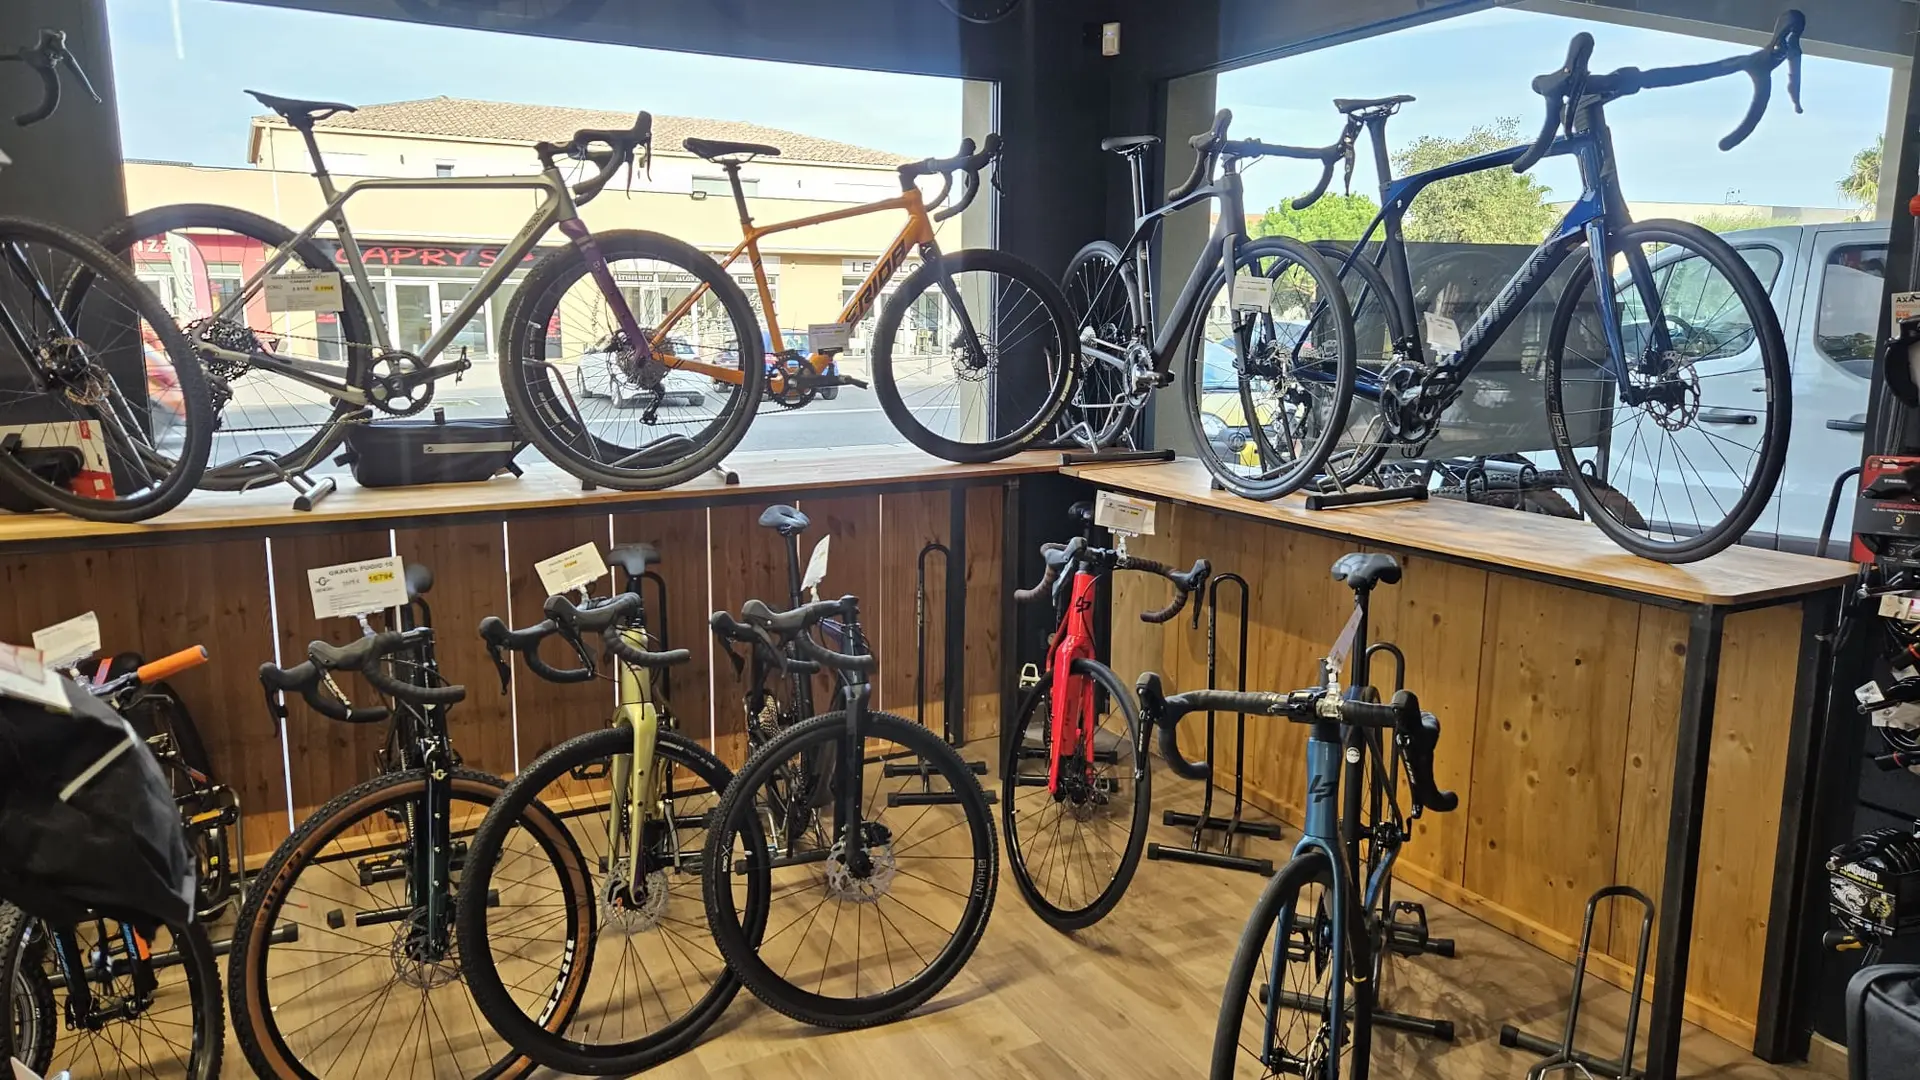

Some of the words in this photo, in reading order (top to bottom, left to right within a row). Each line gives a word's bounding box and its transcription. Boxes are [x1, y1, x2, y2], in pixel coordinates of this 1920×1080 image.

[136, 239, 172, 254] IZZ
[1895, 295, 1915, 303] AXA
[328, 567, 358, 576] GRAVEL
[974, 870, 987, 900] HUNT
